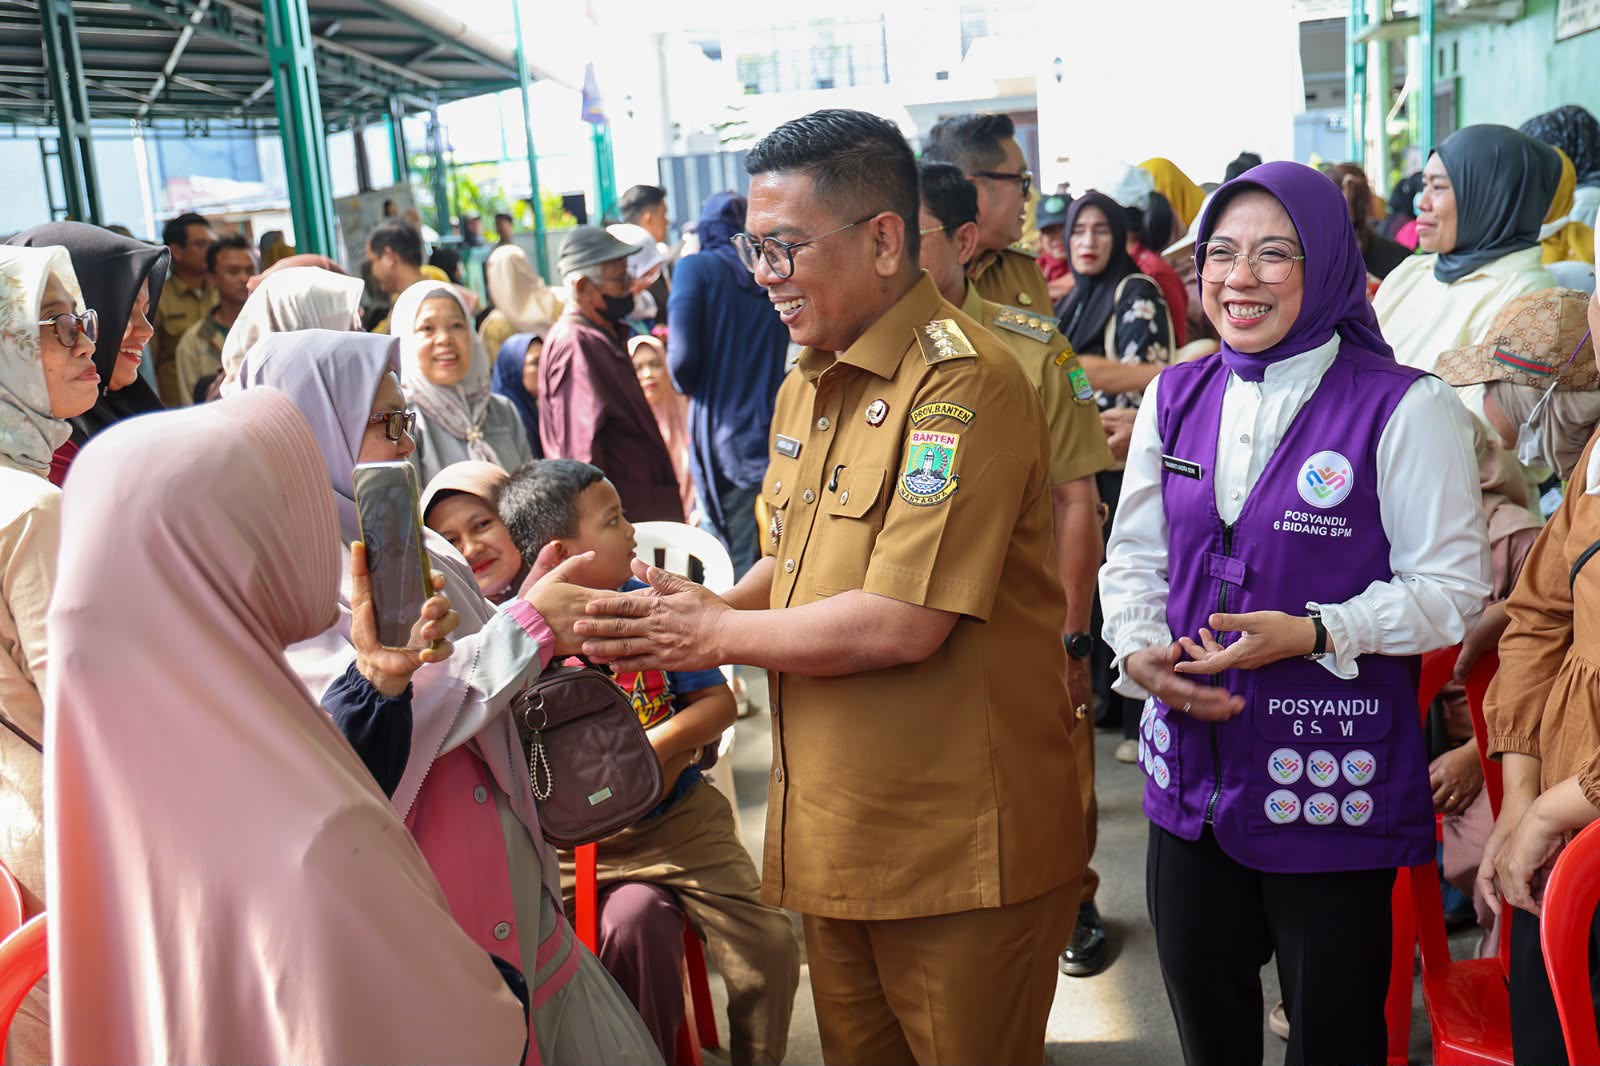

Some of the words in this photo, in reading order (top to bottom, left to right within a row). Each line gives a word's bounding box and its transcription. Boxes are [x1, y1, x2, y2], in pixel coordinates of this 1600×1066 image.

[912, 433, 955, 445] BANTEN
[1284, 510, 1347, 527] POSYANDU
[1273, 520, 1281, 530] 6
[1282, 521, 1328, 536] BIDANG
[1330, 527, 1353, 537] SPM
[1268, 698, 1379, 716] POSYANDU
[1293, 719, 1304, 736] 6
